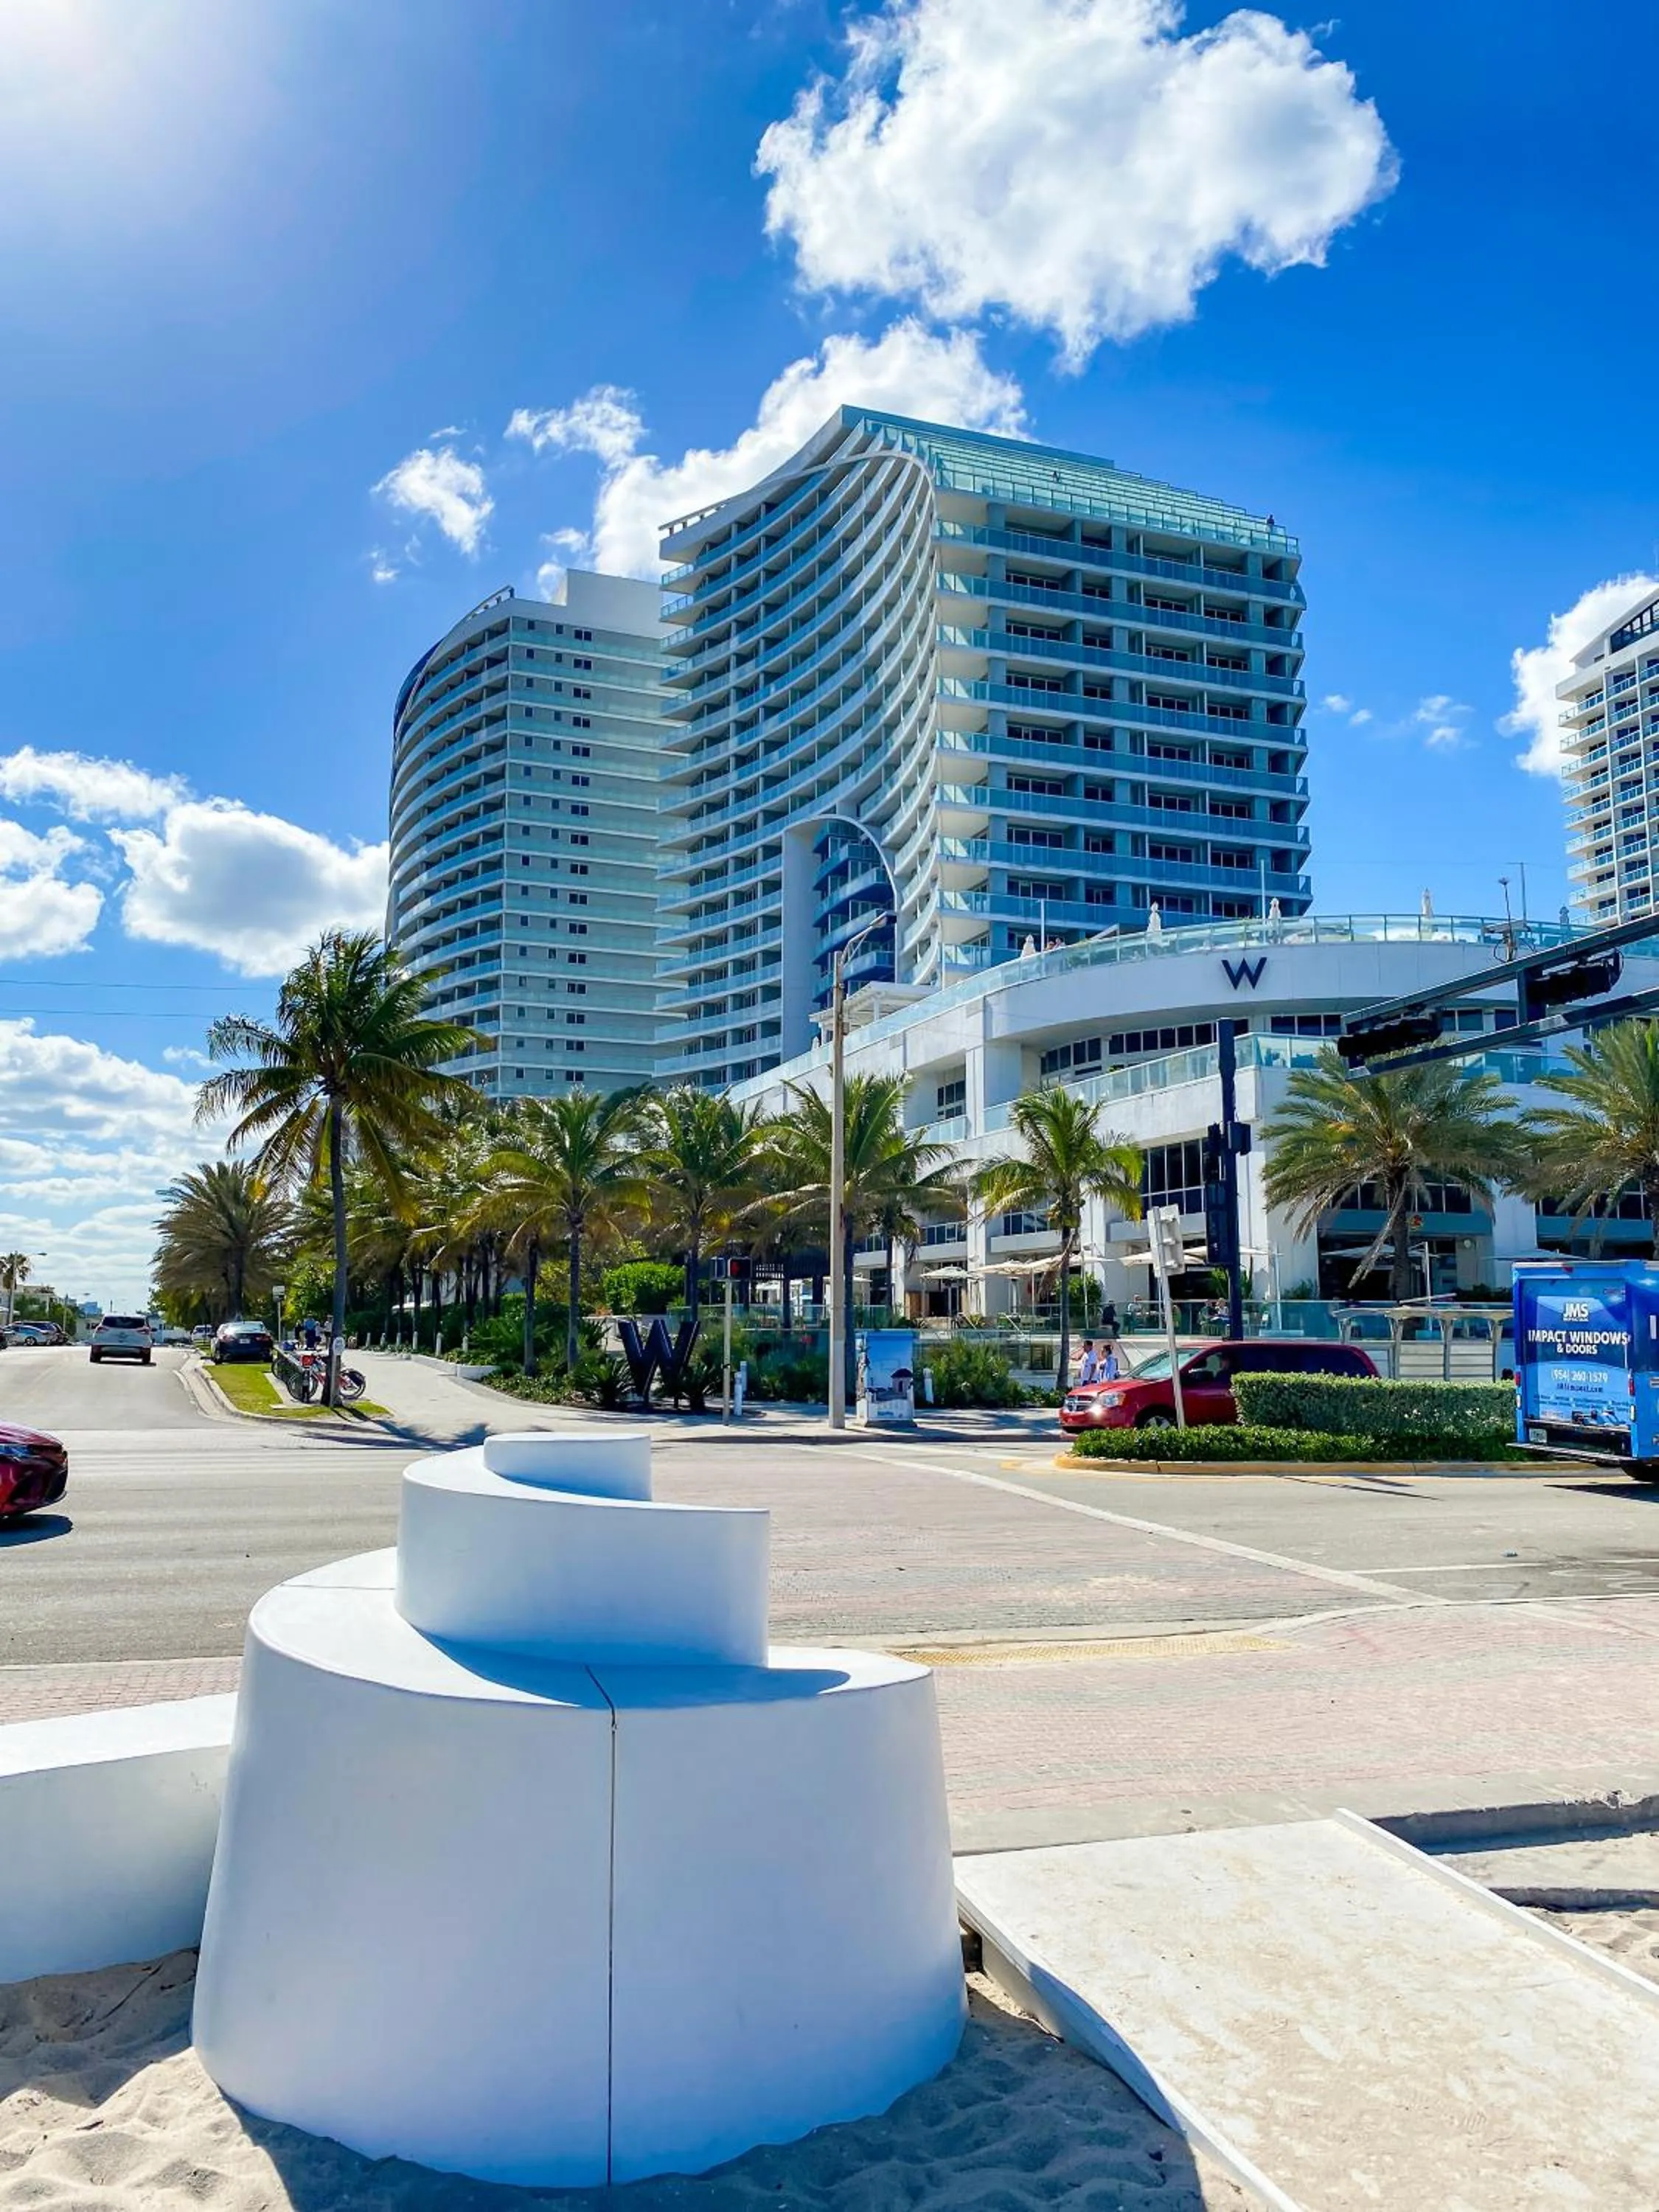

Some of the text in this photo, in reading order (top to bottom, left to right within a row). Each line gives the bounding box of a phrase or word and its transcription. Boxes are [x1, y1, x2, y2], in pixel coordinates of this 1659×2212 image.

[1221, 957, 1267, 990] W
[1563, 1303, 1589, 1318] JMS
[1528, 1329, 1628, 1346] IMPACT WINDOWS
[1557, 1343, 1598, 1354] & DOORS
[618, 1318, 700, 1407] W
